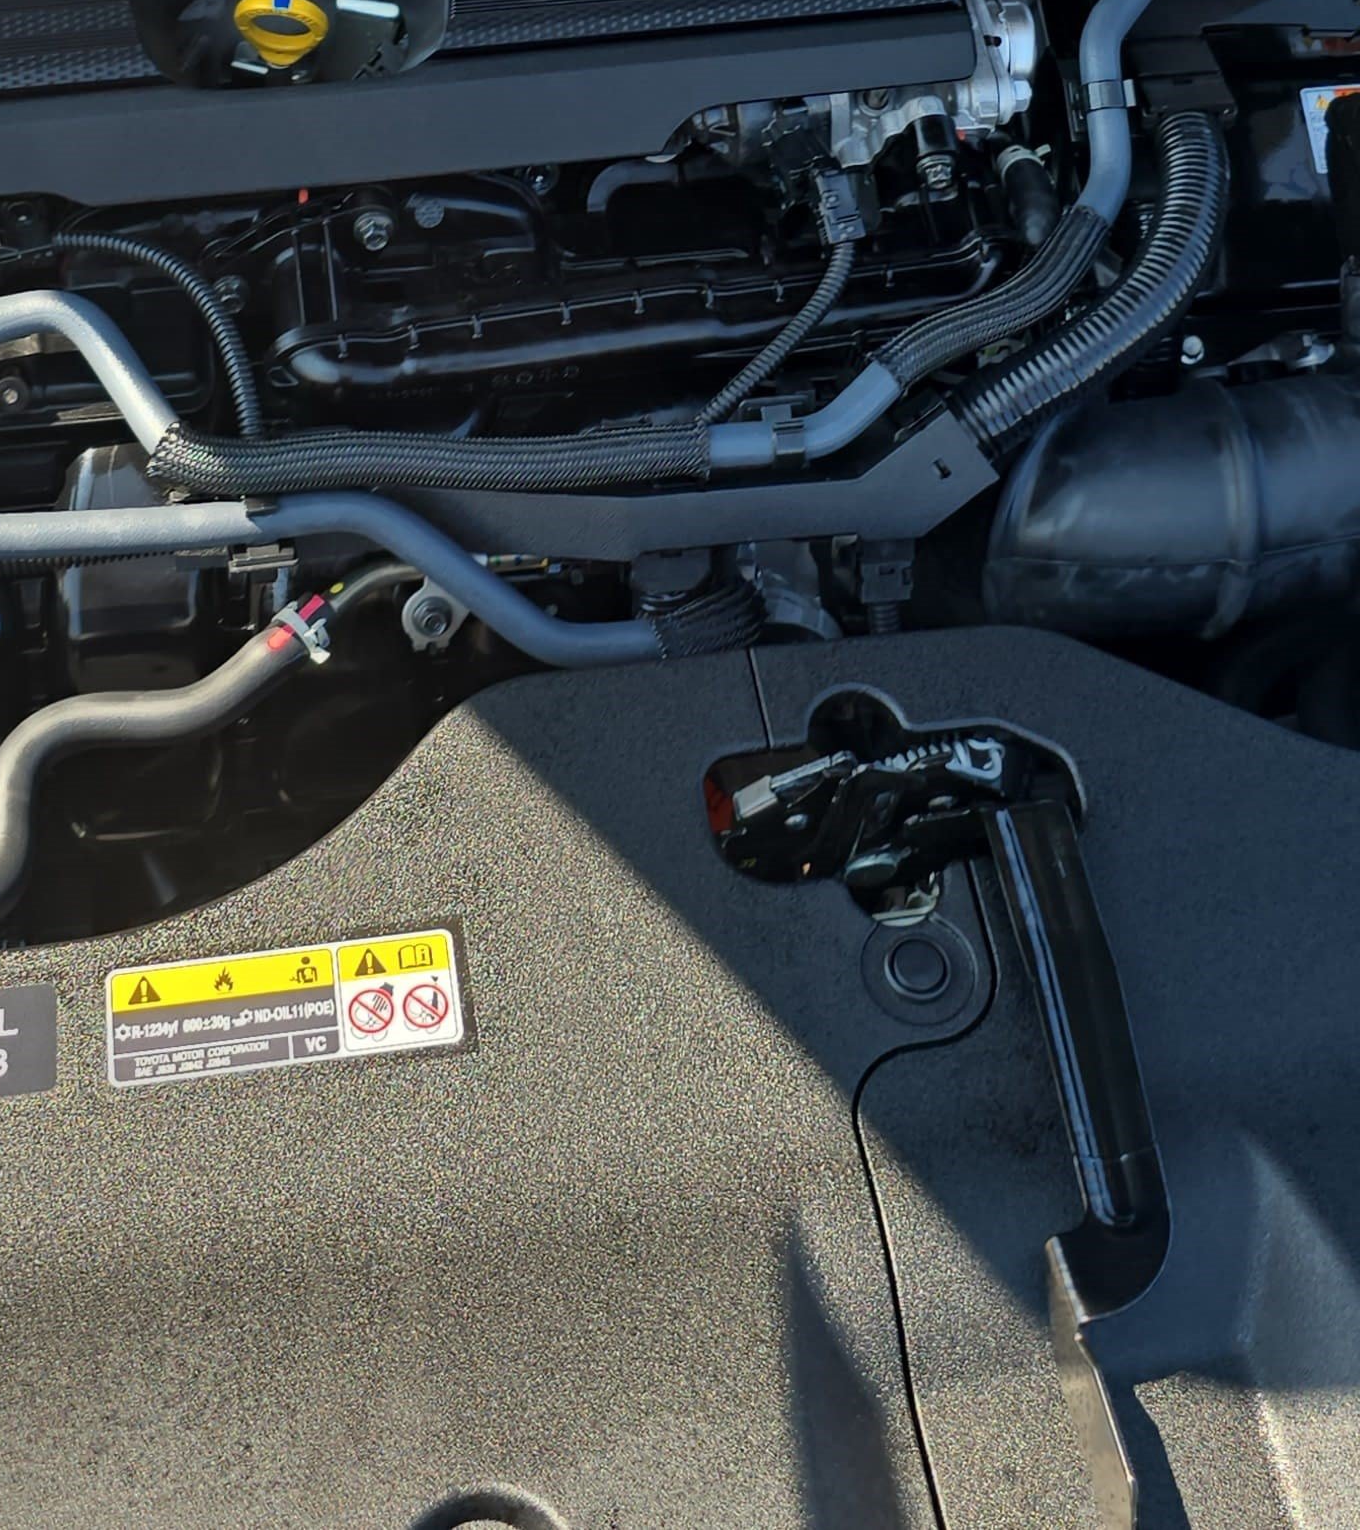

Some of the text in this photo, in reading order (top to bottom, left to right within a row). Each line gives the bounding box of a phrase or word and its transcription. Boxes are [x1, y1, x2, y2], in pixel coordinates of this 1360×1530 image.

[134, 1040, 270, 1068] TOYOTA MOTOR CORPORATION
[305, 1036, 327, 1052] VC
